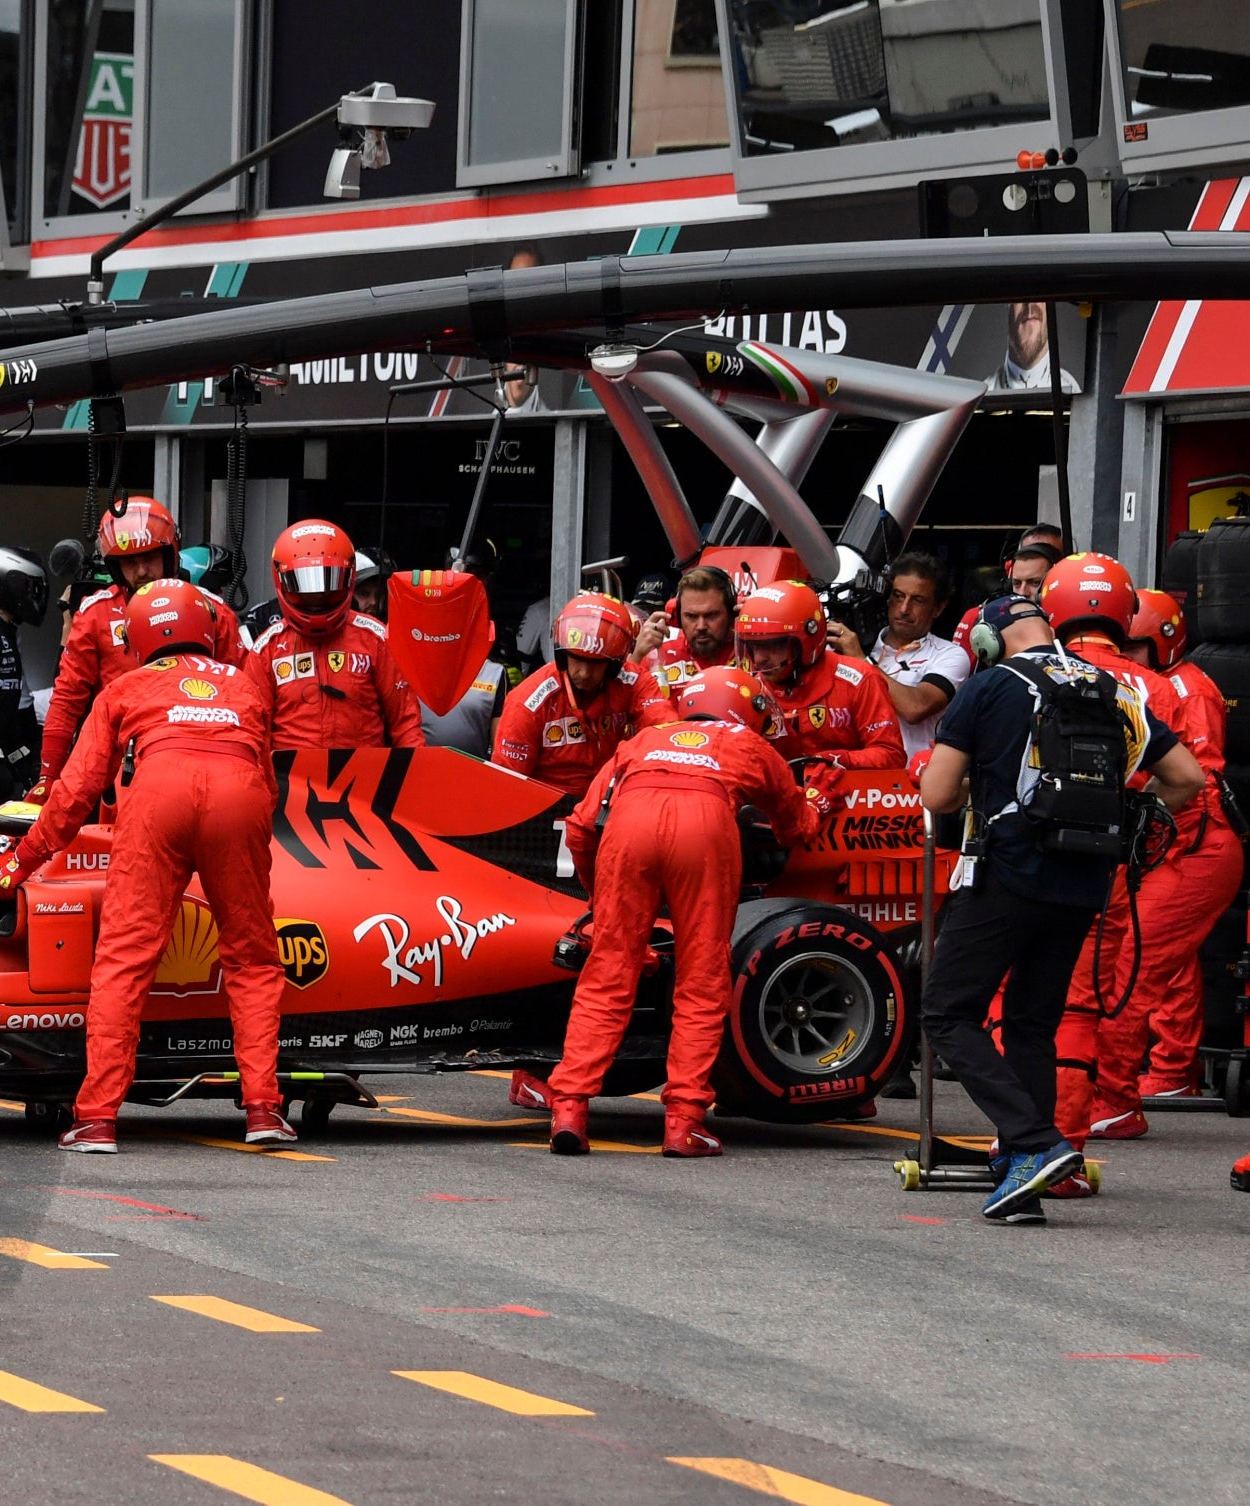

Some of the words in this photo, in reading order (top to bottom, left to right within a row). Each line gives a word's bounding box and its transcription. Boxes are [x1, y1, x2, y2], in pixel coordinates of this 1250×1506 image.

[1126, 495, 1133, 519] 4
[423, 633, 460, 642] brembo
[297, 660, 312, 673] ups
[66, 853, 109, 870] HUB
[36, 903, 57, 912] Niki
[278, 936, 326, 977] ups
[747, 949, 762, 977] P
[774, 921, 873, 951] ZERO
[390, 1024, 418, 1040] NGK
[423, 1024, 463, 1039] brembo
[309, 1034, 348, 1048] SKF
[789, 1075, 866, 1104] PIRELLI
